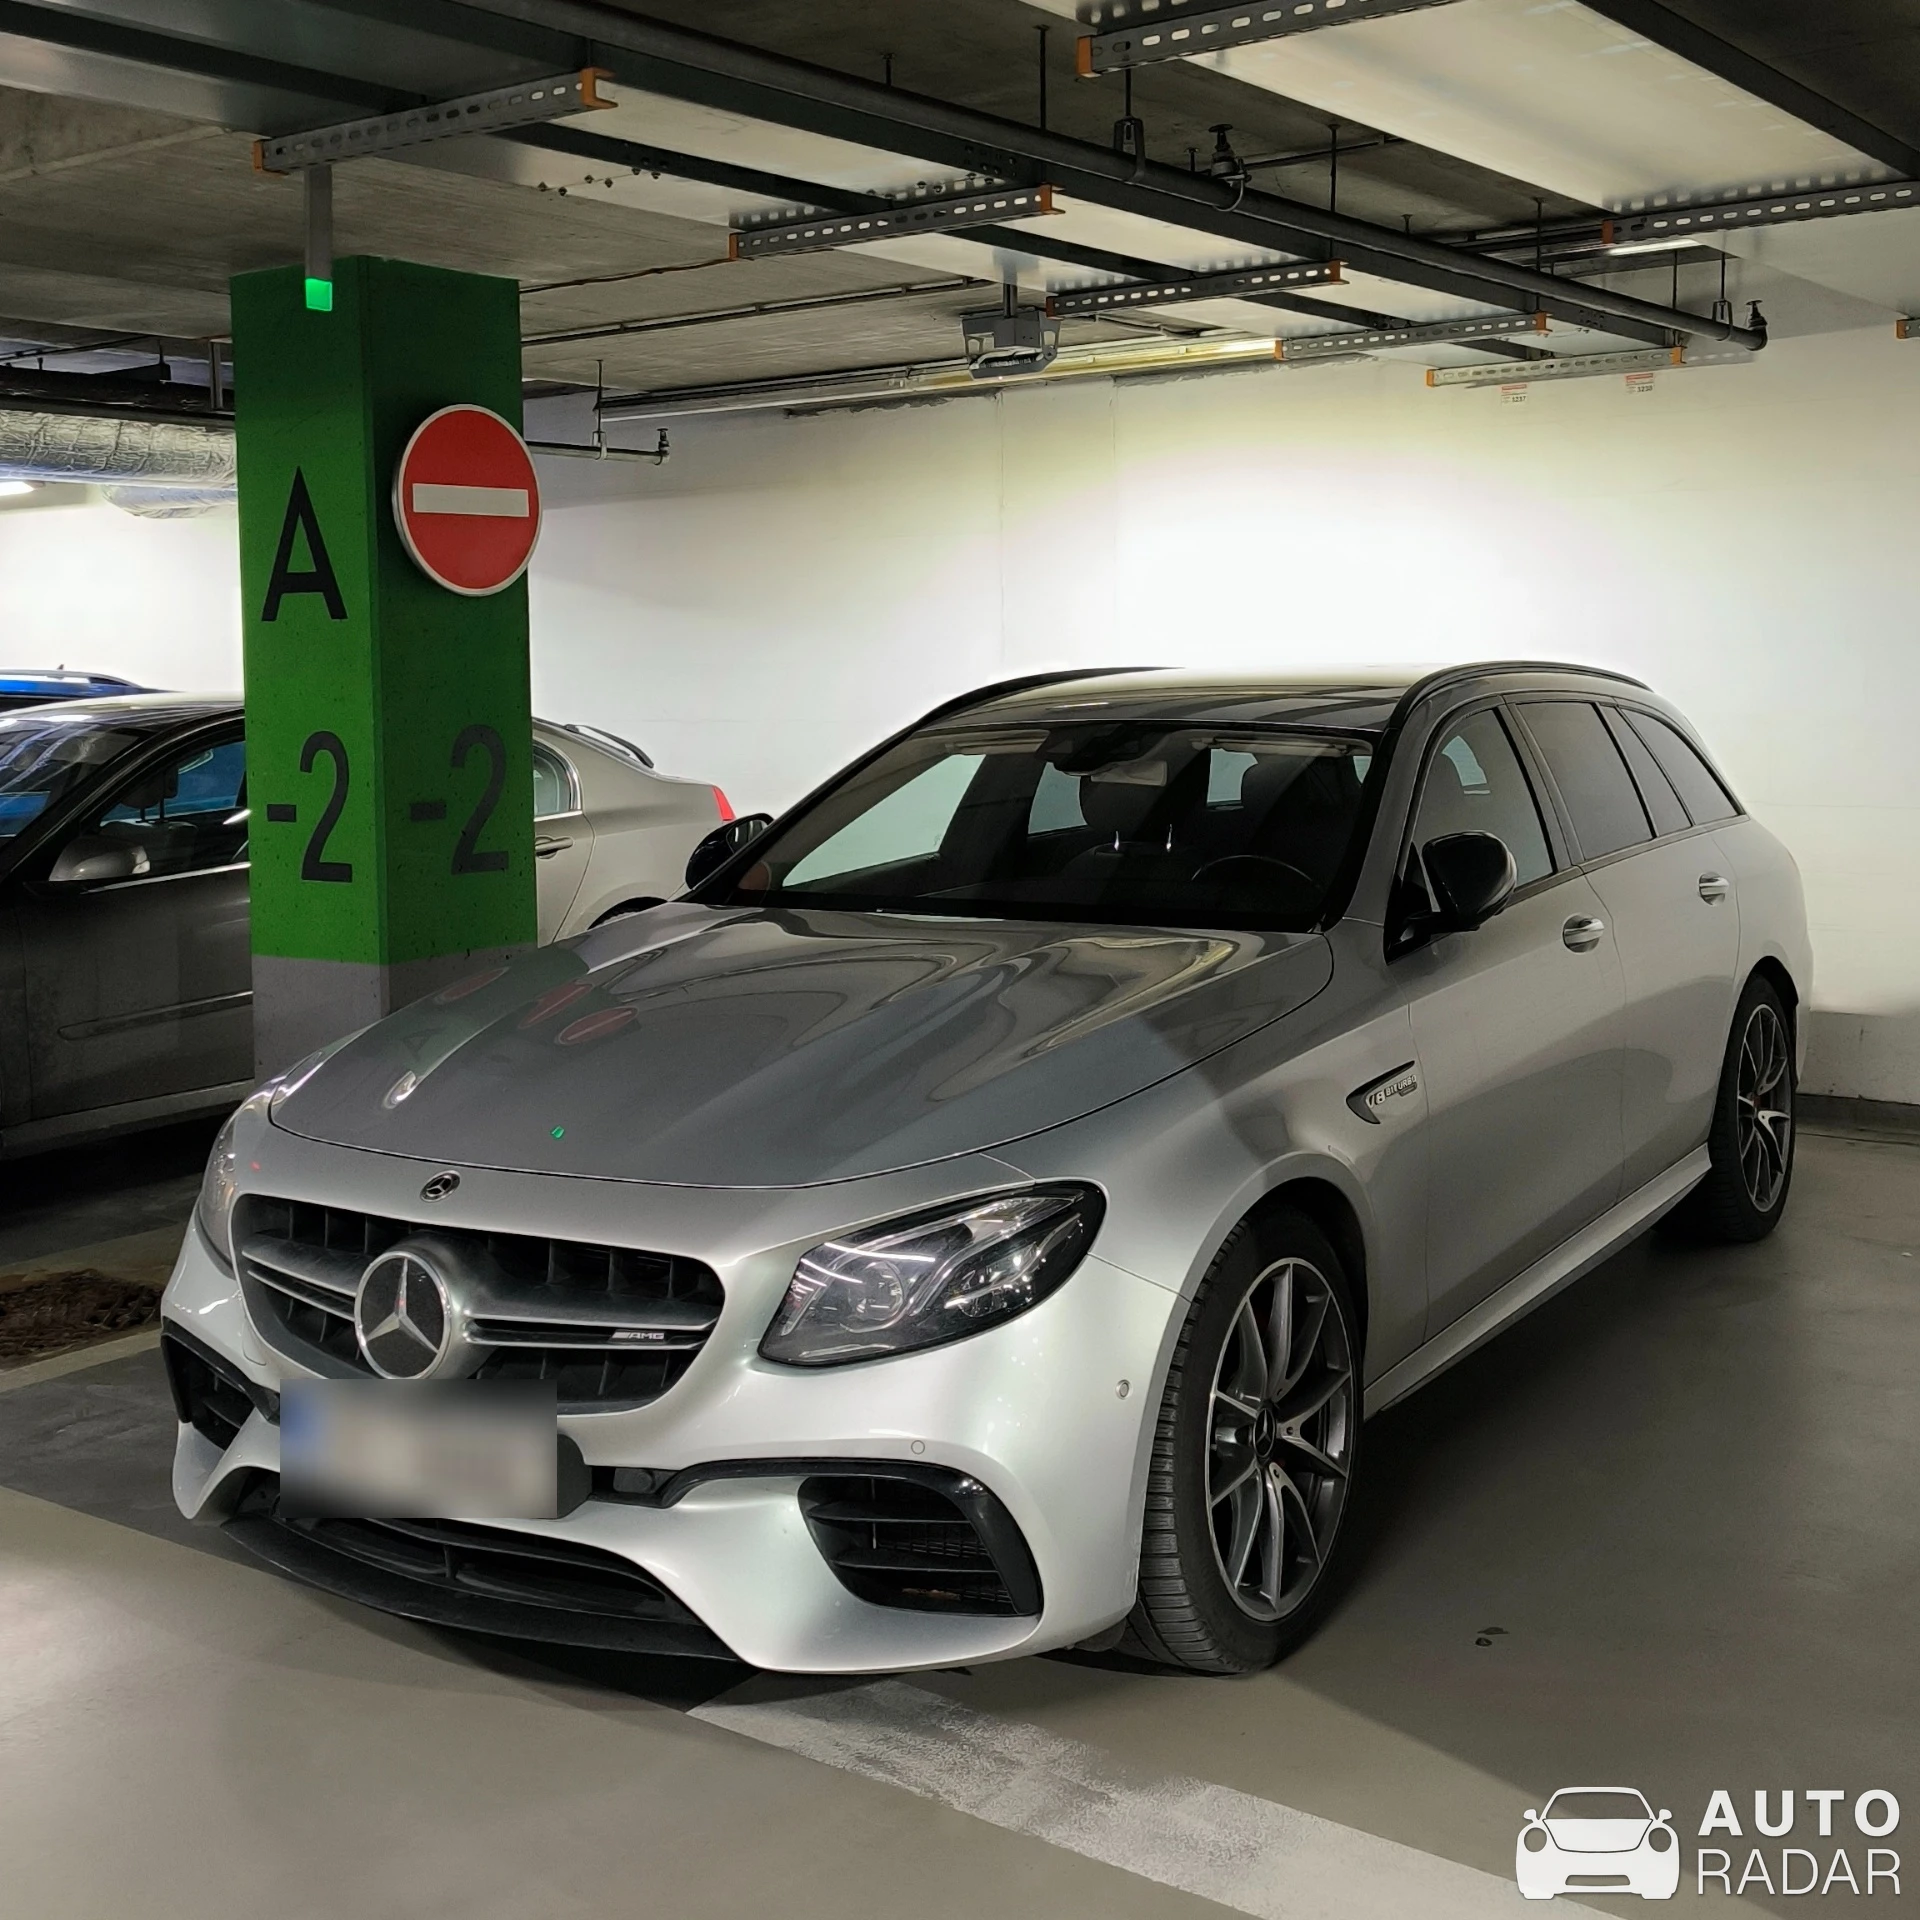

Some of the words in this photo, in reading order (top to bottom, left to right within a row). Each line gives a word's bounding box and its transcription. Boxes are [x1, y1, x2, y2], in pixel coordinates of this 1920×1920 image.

[261, 466, 348, 621] A
[266, 730, 353, 883] -2
[410, 724, 509, 875] -2
[1366, 1089, 1386, 1109] V8
[1385, 1075, 1417, 1097] BITURBO
